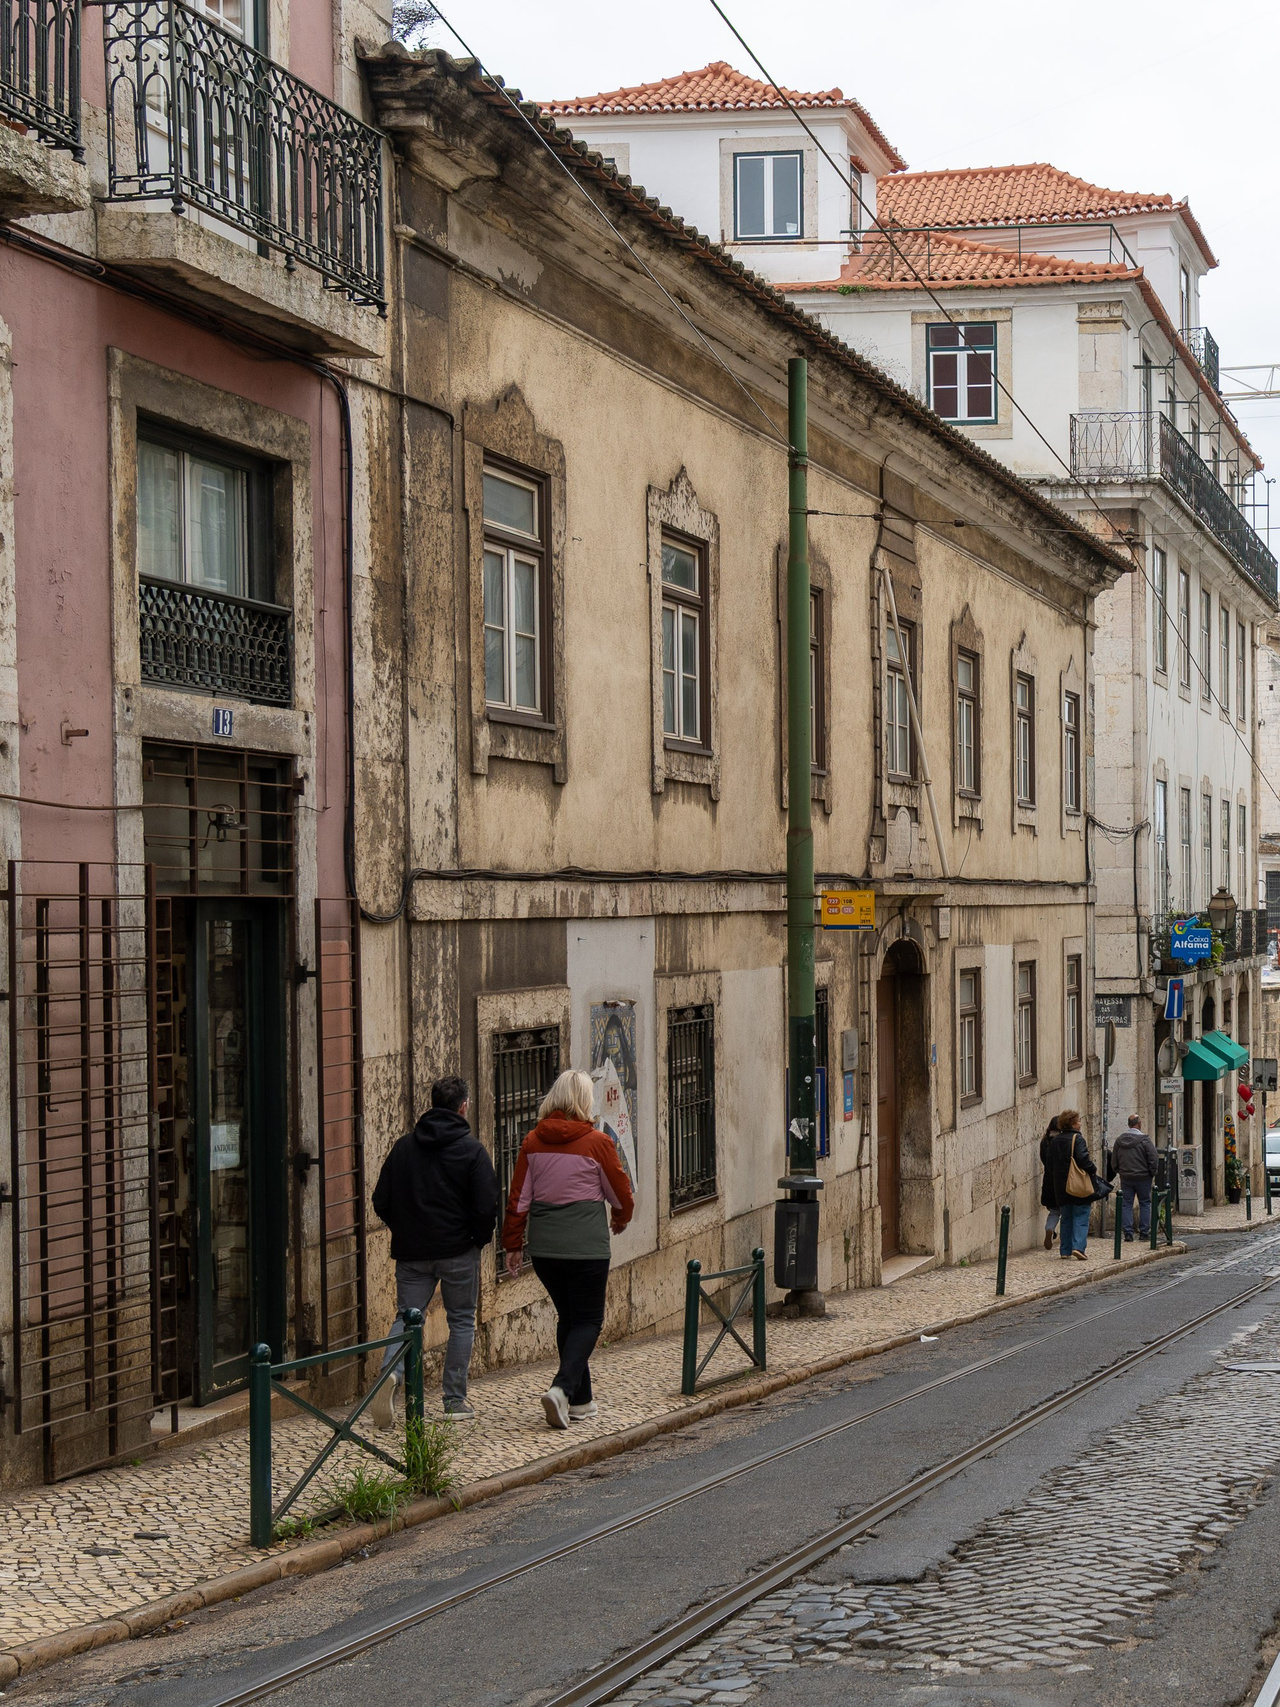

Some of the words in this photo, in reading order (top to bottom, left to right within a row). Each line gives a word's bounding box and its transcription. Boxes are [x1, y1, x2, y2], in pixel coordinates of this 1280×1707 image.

[219, 710, 230, 735] 13
[1187, 934, 1209, 943] Caixa
[1174, 940, 1209, 949] Alfama
[1095, 997, 1123, 1005] RAVESSA
[213, 1144, 238, 1153] ANTIQUES
